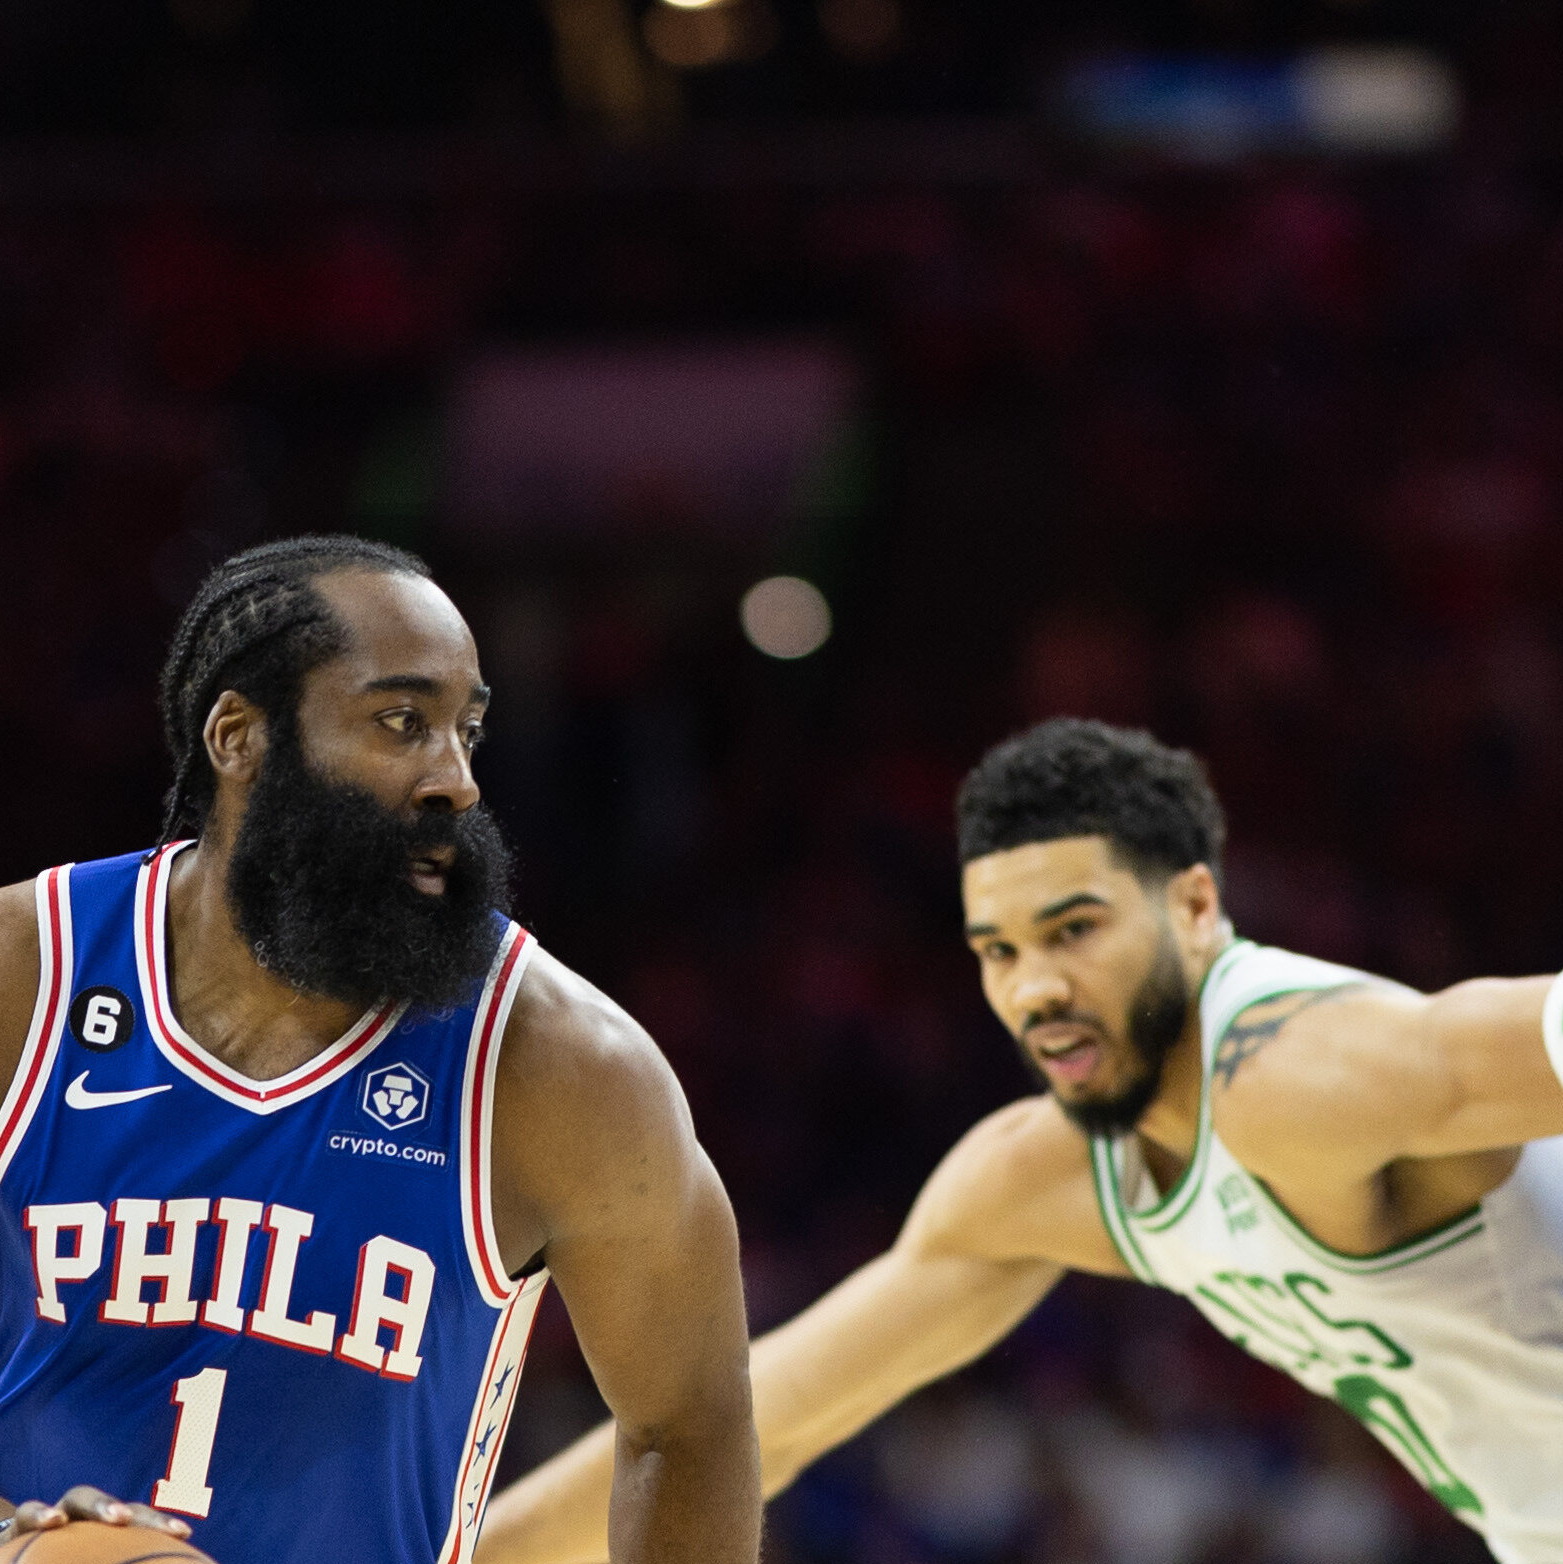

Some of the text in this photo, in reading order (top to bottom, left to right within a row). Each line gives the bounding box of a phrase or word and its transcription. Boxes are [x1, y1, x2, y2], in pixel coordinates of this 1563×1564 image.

[82, 995, 122, 1046] 6
[329, 1132, 447, 1168] crypto.com
[23, 1197, 437, 1383] PHILA
[150, 1367, 228, 1519] 1
